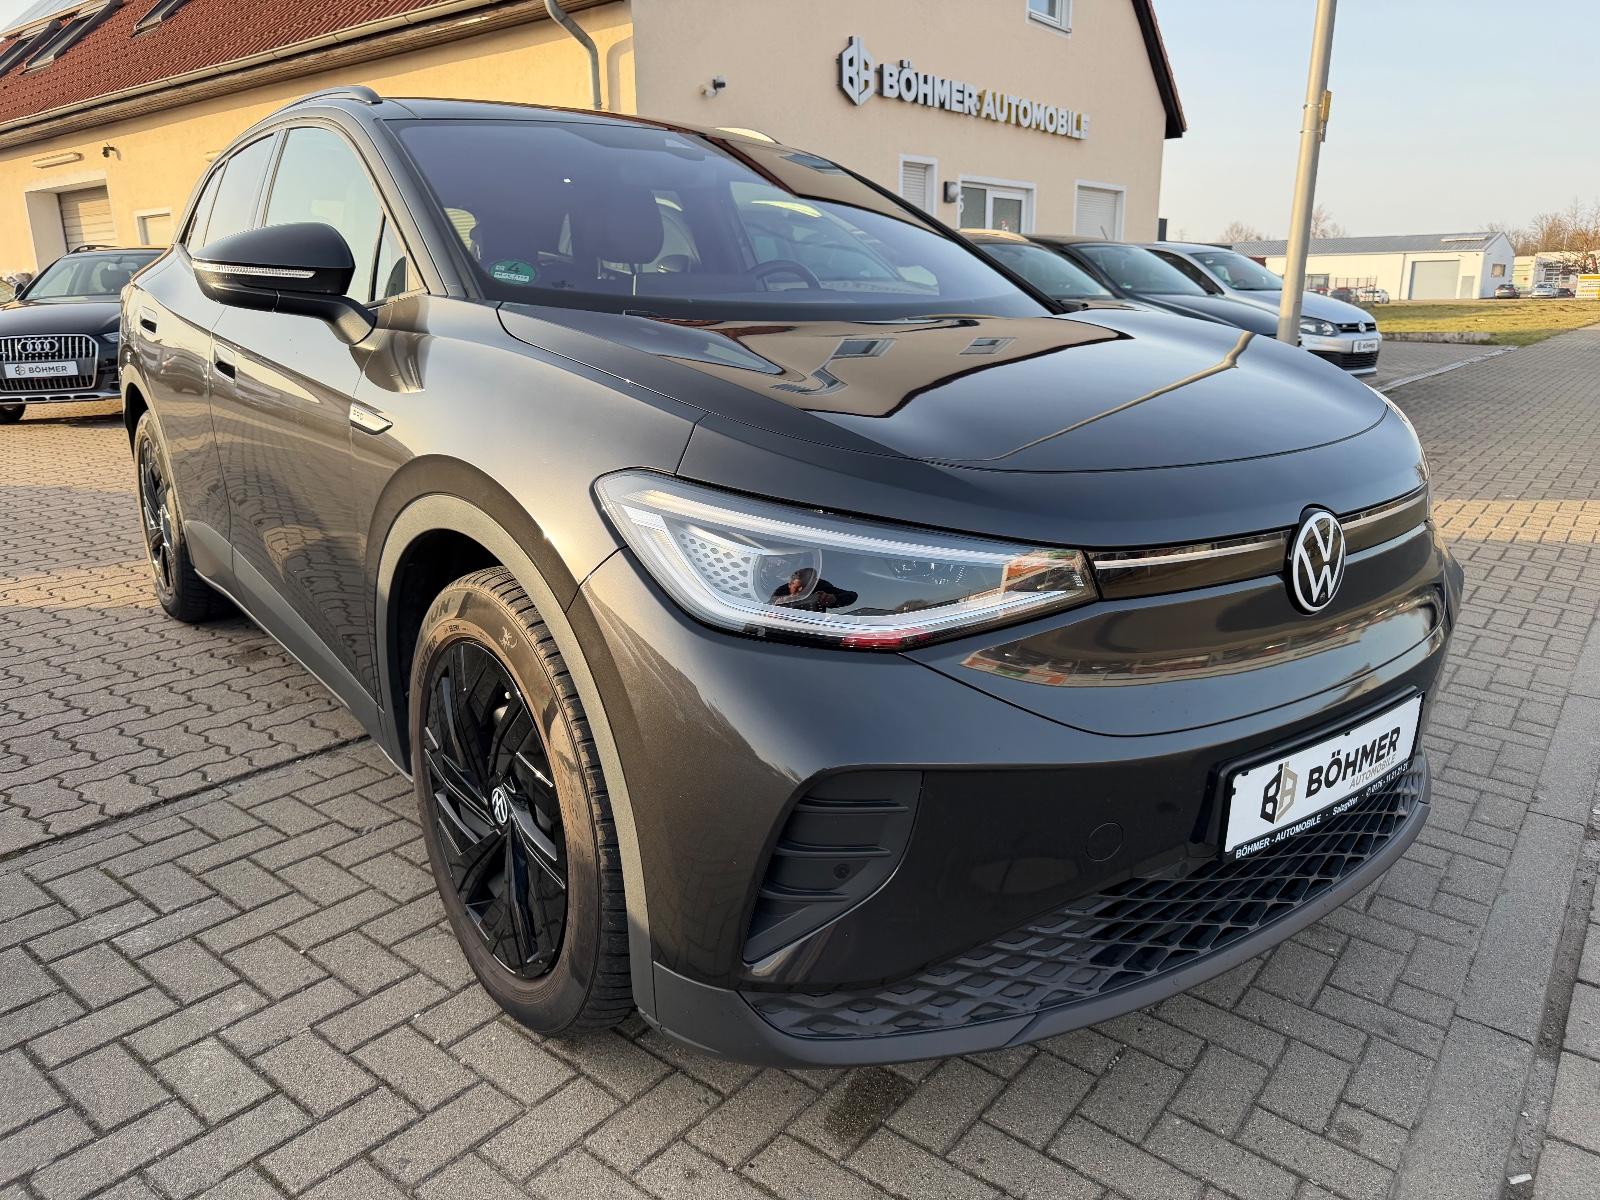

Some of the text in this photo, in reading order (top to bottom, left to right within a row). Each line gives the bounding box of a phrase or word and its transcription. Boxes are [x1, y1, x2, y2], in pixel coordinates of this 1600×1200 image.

[880, 59, 1090, 140] BÖHMER AUTOMOBILE
[28, 365, 68, 374] BÖHMER
[417, 634, 438, 689] WINTER
[1305, 726, 1401, 799] BÖHMER
[1349, 752, 1397, 790] AUTOMOBILE
[1235, 837, 1270, 859] BÖHMER
[1275, 814, 1322, 843] AUTOMOBILE
